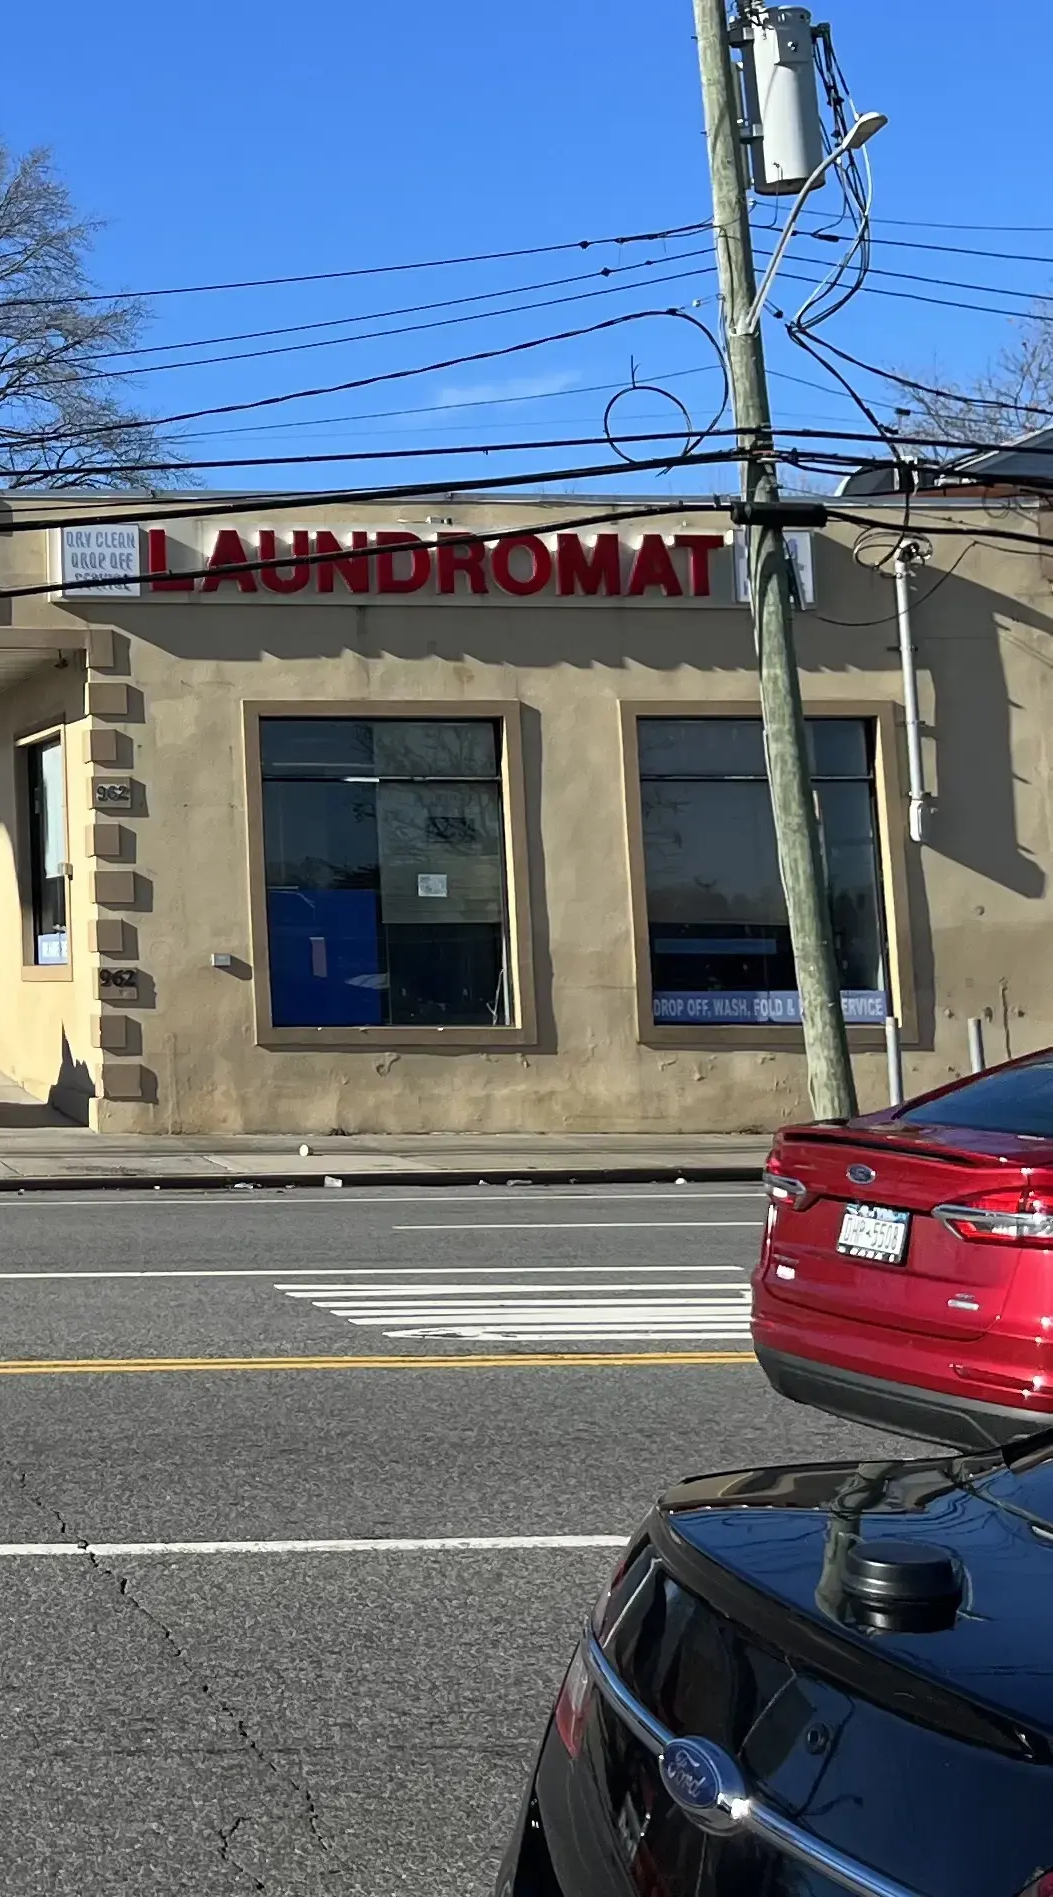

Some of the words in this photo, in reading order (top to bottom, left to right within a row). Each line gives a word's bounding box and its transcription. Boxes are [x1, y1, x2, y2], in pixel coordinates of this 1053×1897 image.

[66, 531, 92, 549] DRY
[96, 532, 136, 549] CLEAN
[71, 552, 107, 570] DROP
[109, 552, 134, 571] OFF
[149, 529, 724, 597] LAUNDROMAT
[96, 786, 129, 802] 962
[99, 969, 137, 987] 962
[653, 999, 684, 1016] DROP
[687, 998, 711, 1018] OFF,
[754, 998, 783, 1016] FOLD
[786, 998, 796, 1016] &
[841, 998, 884, 1016] ERVICE
[667, 1749, 707, 1798] Ford
